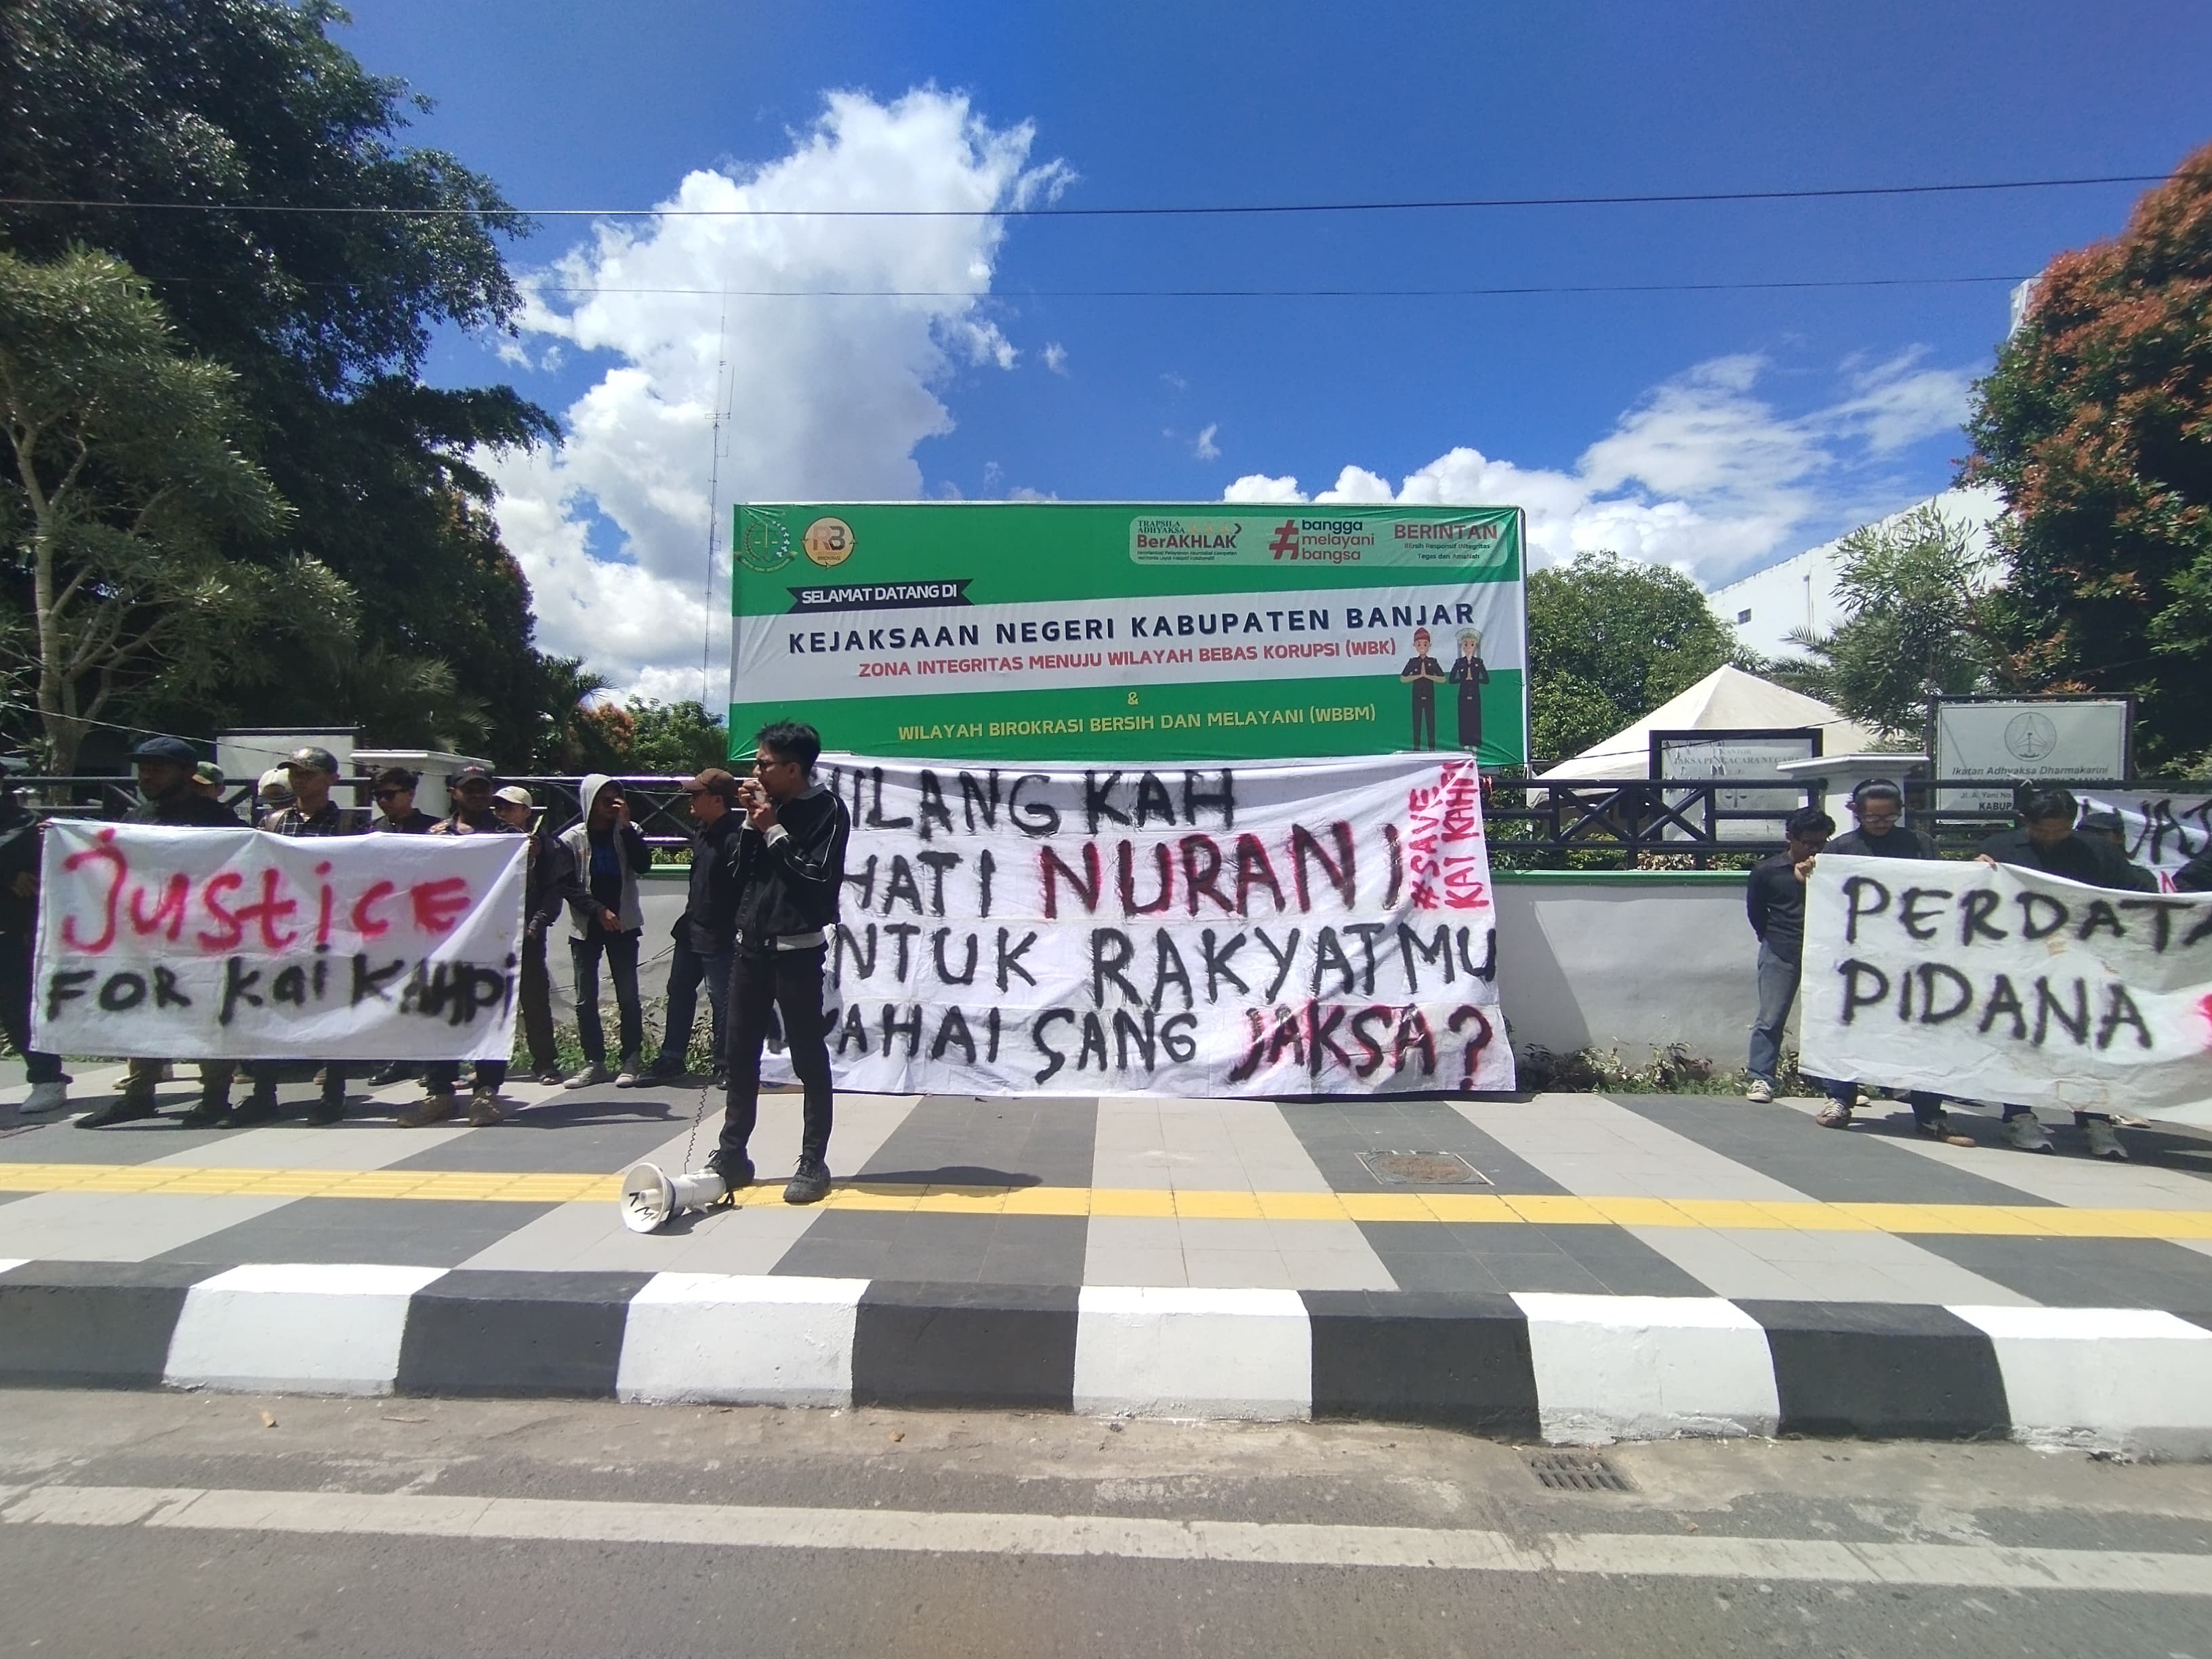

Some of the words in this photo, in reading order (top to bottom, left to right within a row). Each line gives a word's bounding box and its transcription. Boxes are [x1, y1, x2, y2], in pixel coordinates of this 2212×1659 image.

[1137, 534, 1237, 548] BerAKHLAK
[1302, 520, 1363, 535] bangga
[1302, 533, 1374, 549] melayani
[1394, 524, 1497, 540] BERINTAN
[1302, 548, 1361, 564] bangsa
[802, 588, 872, 605] SELAMAT
[874, 585, 939, 601] DATANG
[942, 583, 957, 598] DI
[790, 625, 979, 654] KEJAKSAAN
[996, 618, 1114, 644] NEGERI
[1132, 608, 1330, 638] KABUPATEN
[1347, 602, 1474, 630] BANJAR
[859, 662, 912, 678] ZONA
[918, 656, 1024, 675] INTEGRITAS
[1029, 652, 1103, 670] MENUJU
[1109, 647, 1193, 666] WILAYAH
[1199, 644, 1258, 663] BEBAS
[1263, 641, 1340, 660] KORUPSI
[1345, 638, 1396, 657] (WBK)
[1127, 692, 1139, 705] &
[899, 723, 983, 741] WILAYAH
[989, 718, 1084, 737] BIROKRASI
[1090, 716, 1154, 733] BERSIH
[1162, 712, 1202, 729] DAN
[1207, 708, 1304, 728] MELAYANI
[1309, 703, 1376, 724] (WBBM)
[1952, 766, 1984, 775] Ikatan
[1986, 766, 2036, 776] Adhyaksa
[2039, 766, 2108, 775] Dharmakarini
[1084, 769, 1235, 836] KAH
[1979, 802, 2014, 811] KABUP
[1408, 786, 1443, 909] #SAVE
[1040, 821, 1403, 919] NURANI
[1443, 856, 1490, 909] KAI
[834, 922, 1037, 993] NTUK
[1090, 922, 1496, 1013] RAKYATMU
[47, 967, 191, 1022] FOR
[1837, 957, 2153, 1051] PIDANA
[1033, 1008, 1197, 1084] SANG
